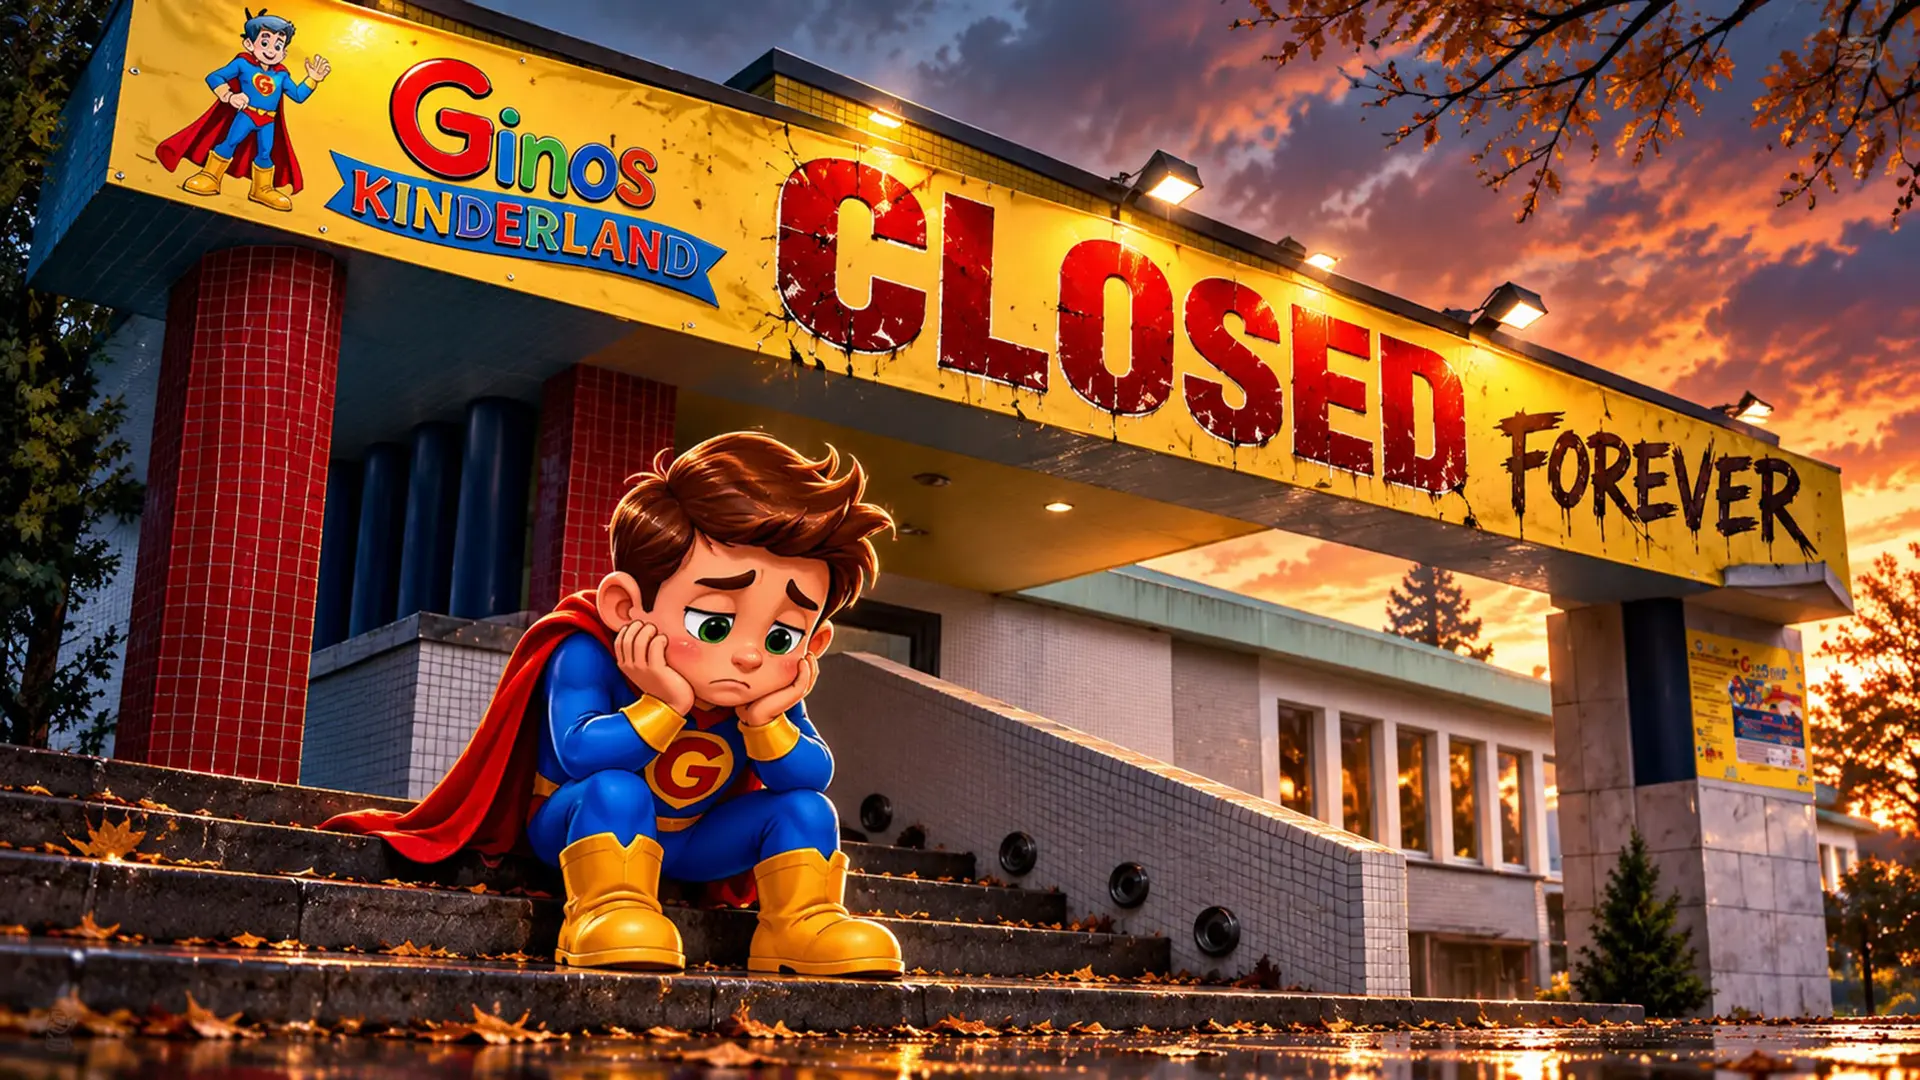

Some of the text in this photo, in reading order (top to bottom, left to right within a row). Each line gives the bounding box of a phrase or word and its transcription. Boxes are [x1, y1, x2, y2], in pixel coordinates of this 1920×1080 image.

[353, 169, 699, 278] KINDERLAND
[776, 157, 1467, 495] CLOSED
[1494, 408, 1819, 558] FOREVER
[654, 736, 724, 800] G
